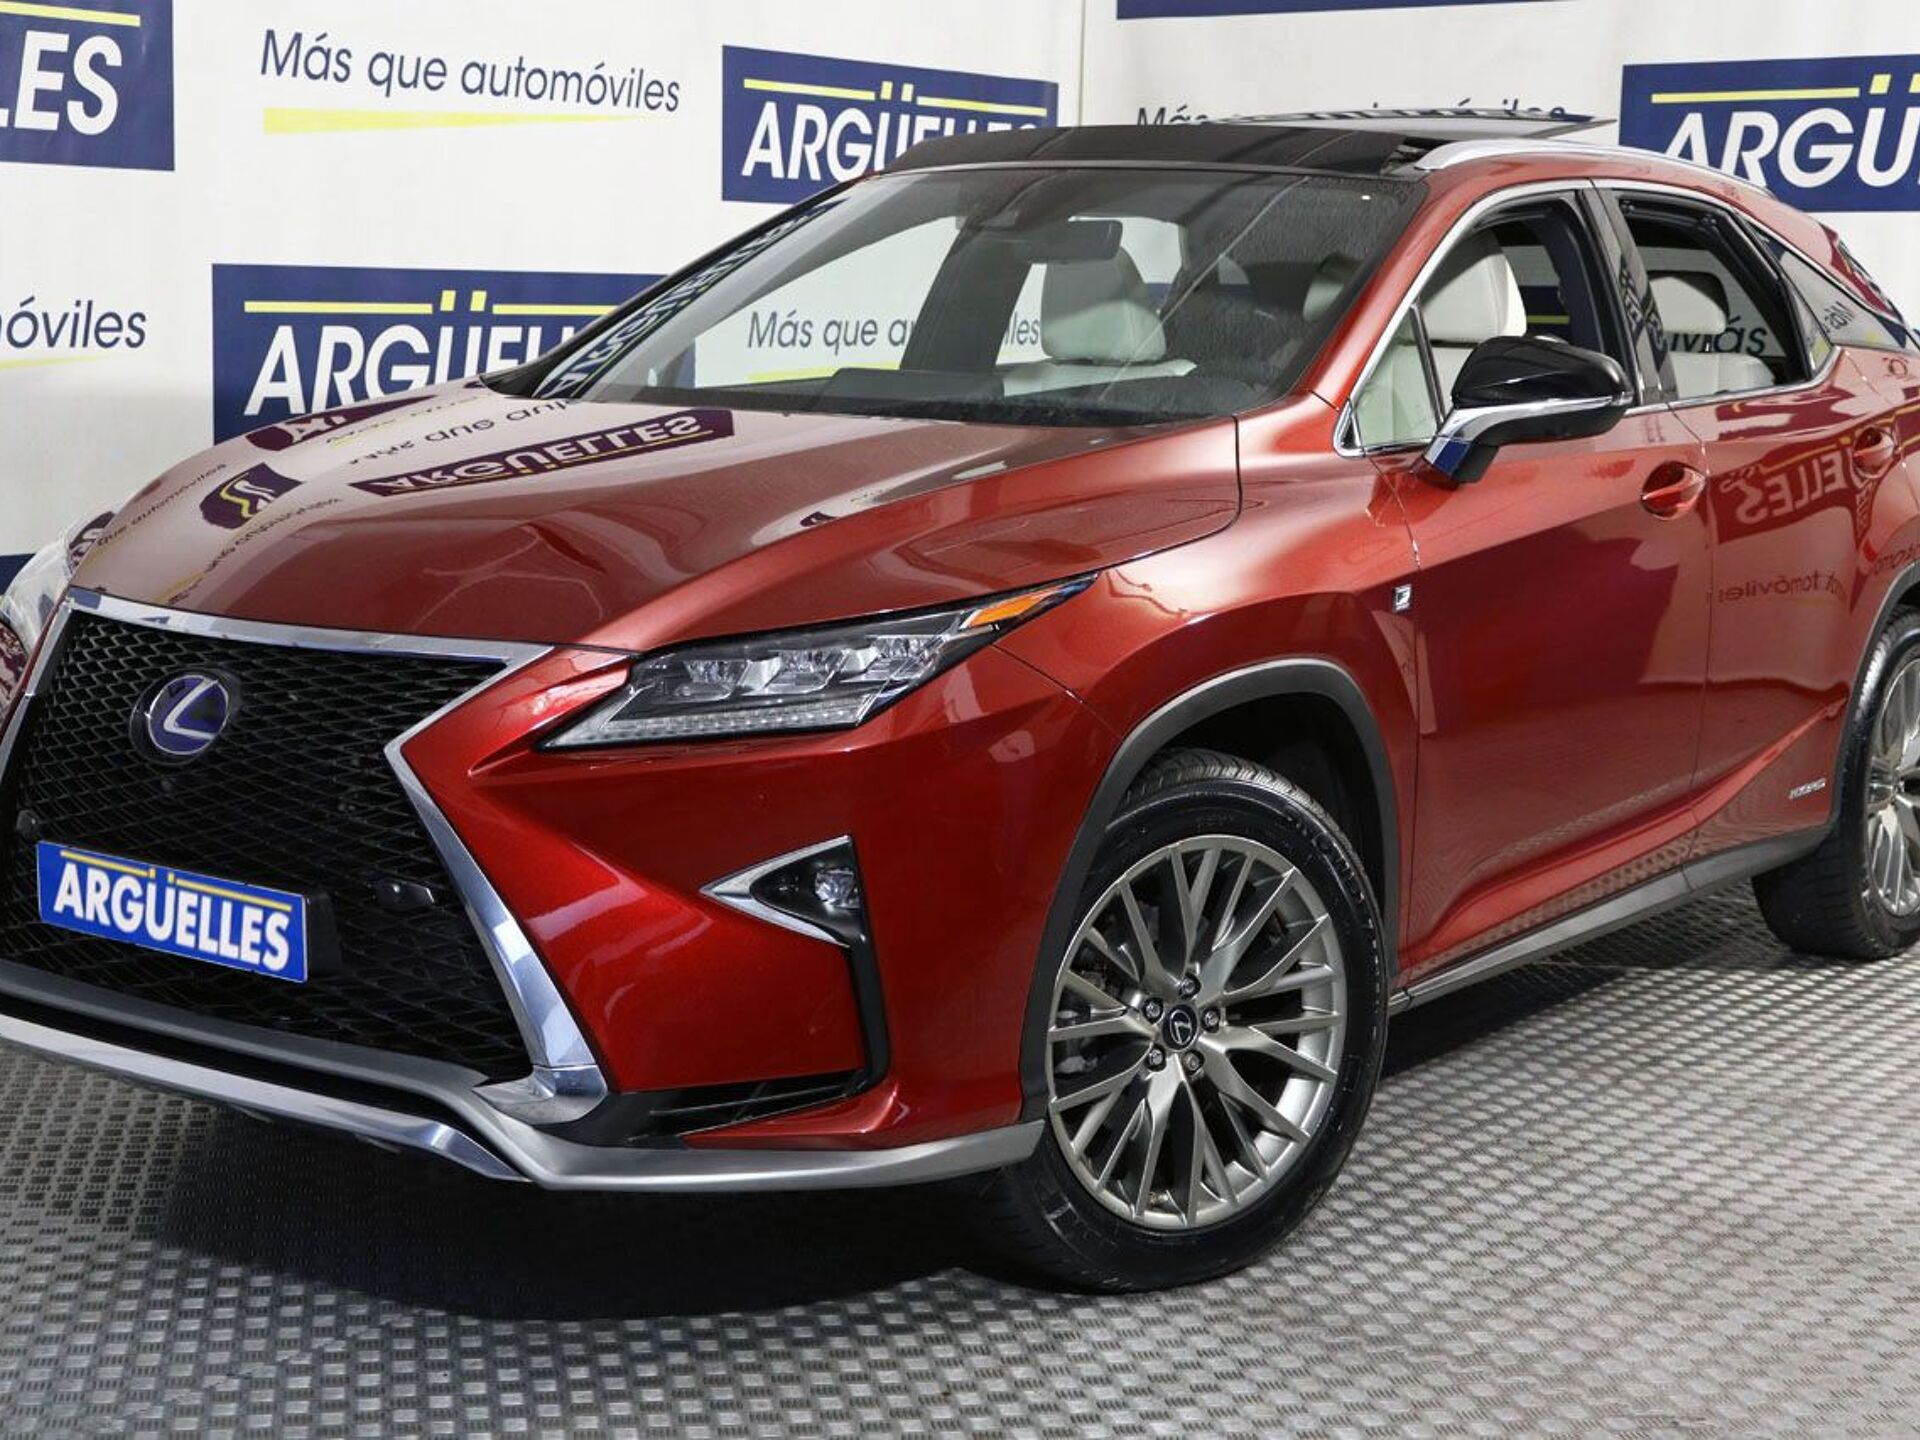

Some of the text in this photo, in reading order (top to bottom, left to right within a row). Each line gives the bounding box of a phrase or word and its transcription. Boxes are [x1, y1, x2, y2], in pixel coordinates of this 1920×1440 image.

[0, 30, 122, 136] ES
[260, 29, 680, 112] Más que automóviles
[1664, 73, 1920, 188] ARGÜ
[0, 296, 147, 348] óviles
[748, 309, 812, 348] Más
[823, 317, 877, 355] que
[53, 861, 290, 971] ARGÜELLES
